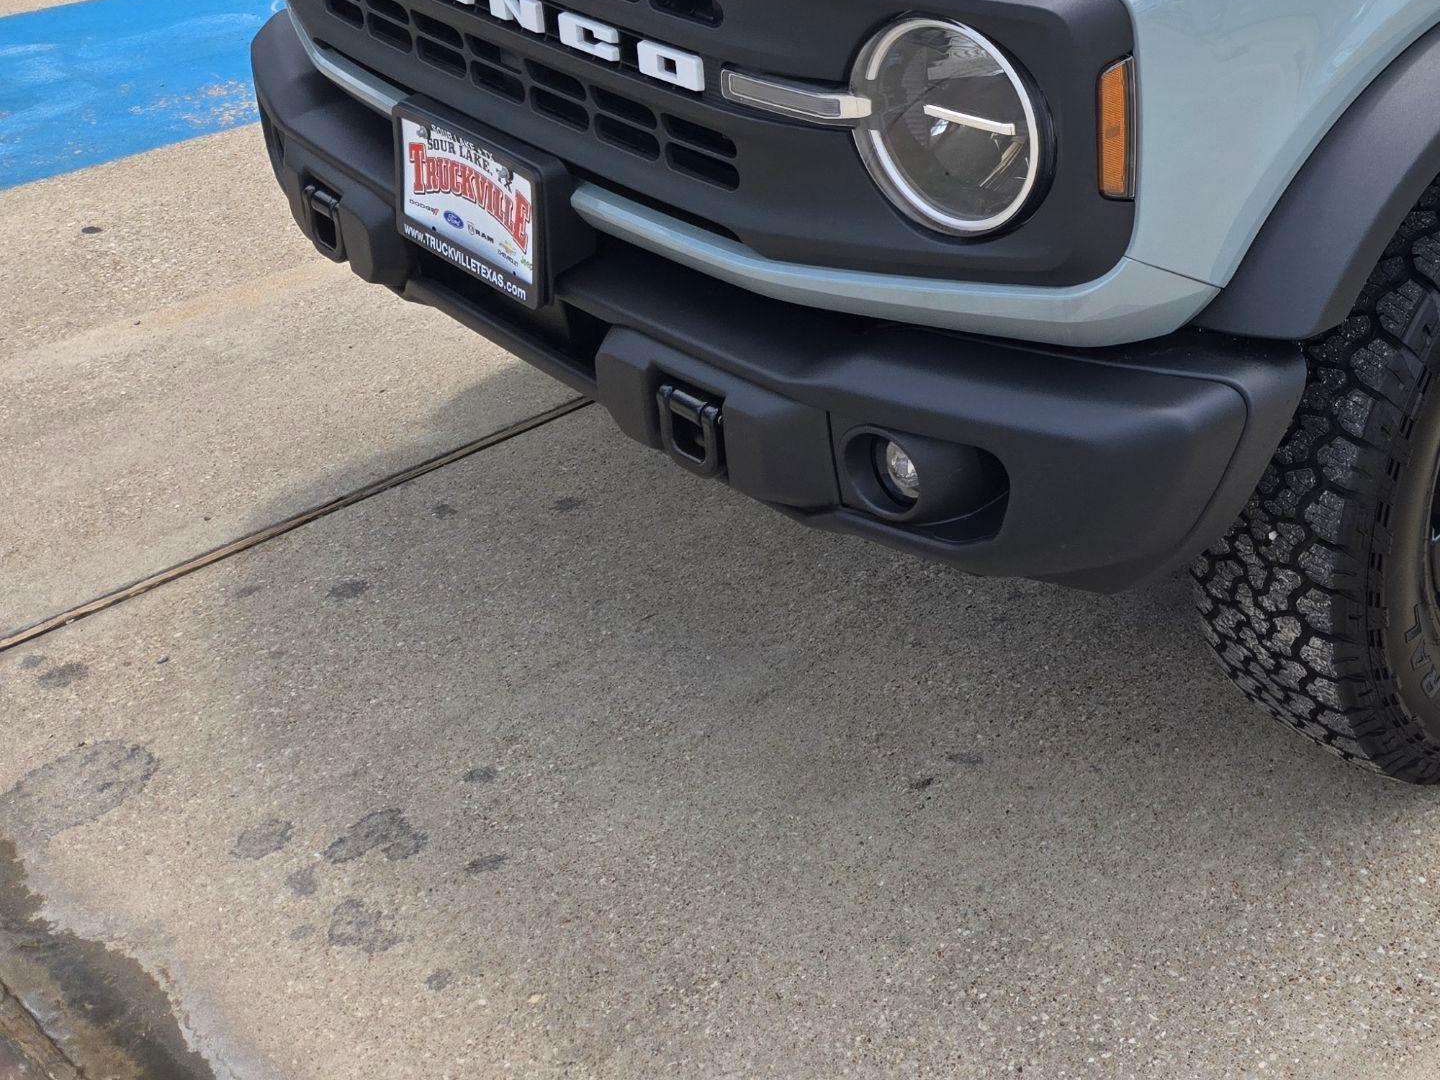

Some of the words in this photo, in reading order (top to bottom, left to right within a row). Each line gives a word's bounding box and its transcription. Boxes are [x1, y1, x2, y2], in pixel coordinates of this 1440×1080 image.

[427, 139, 457, 155] SOUR
[408, 142, 531, 255] TRUCKVILLE
[475, 228, 495, 244] RAM
[404, 223, 527, 301] www.TRUCKVILLETEXAS.com
